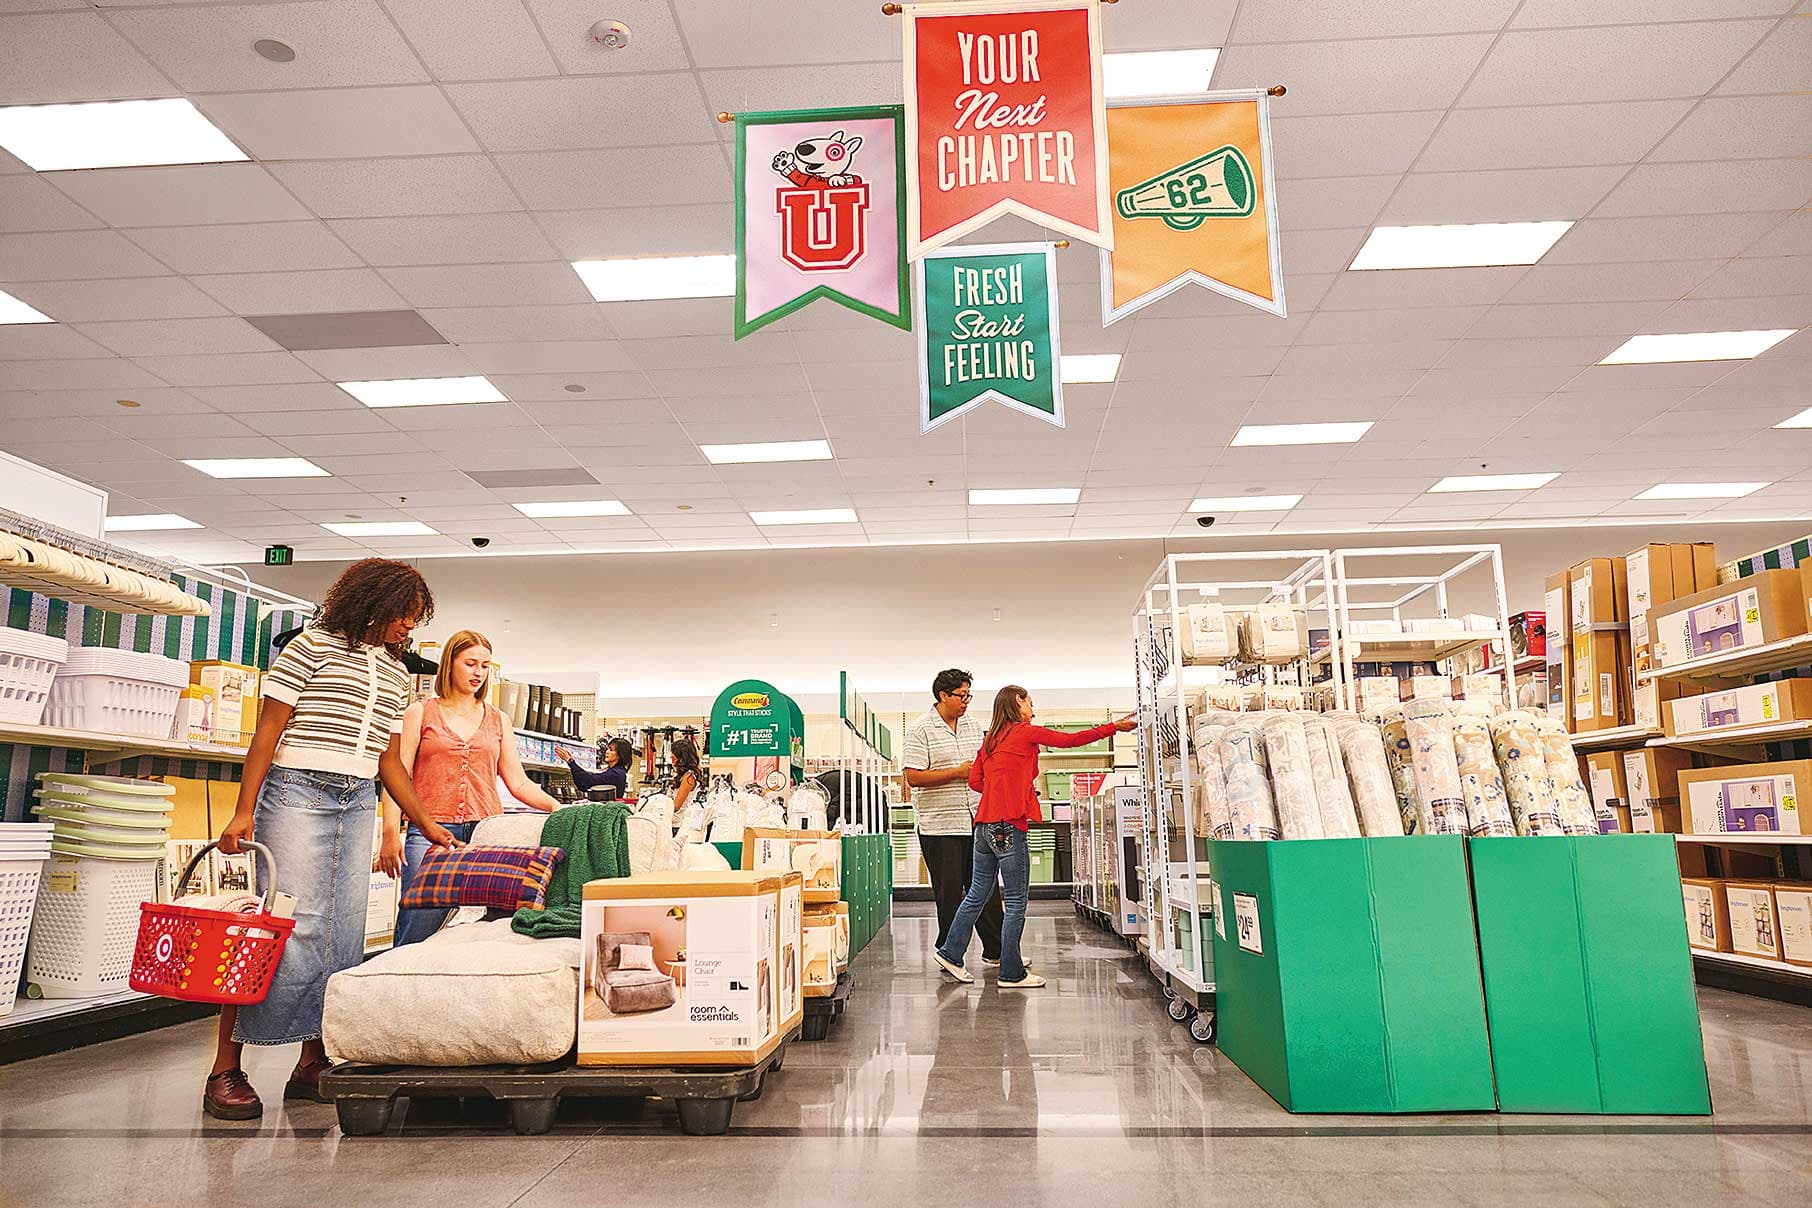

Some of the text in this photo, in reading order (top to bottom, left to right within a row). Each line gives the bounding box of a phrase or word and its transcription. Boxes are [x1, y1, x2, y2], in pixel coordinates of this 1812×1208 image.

[957, 29, 1041, 86] YOUR
[953, 88, 1047, 131] Next
[936, 129, 1078, 193] CHAPTER
[775, 182, 870, 272] U
[953, 262, 1024, 308] FRESH
[951, 308, 1026, 341] Start
[943, 339, 1036, 387] FEELING
[269, 548, 287, 564] EXIT
[732, 696, 765, 706] Command
[727, 709, 742, 717] STYLE
[742, 709, 755, 717] THAT
[726, 729, 749, 746] #1
[694, 959, 722, 968] Lounge
[694, 967, 715, 976] Chair
[690, 1006, 717, 1014] room
[690, 1011, 740, 1022] essentials
